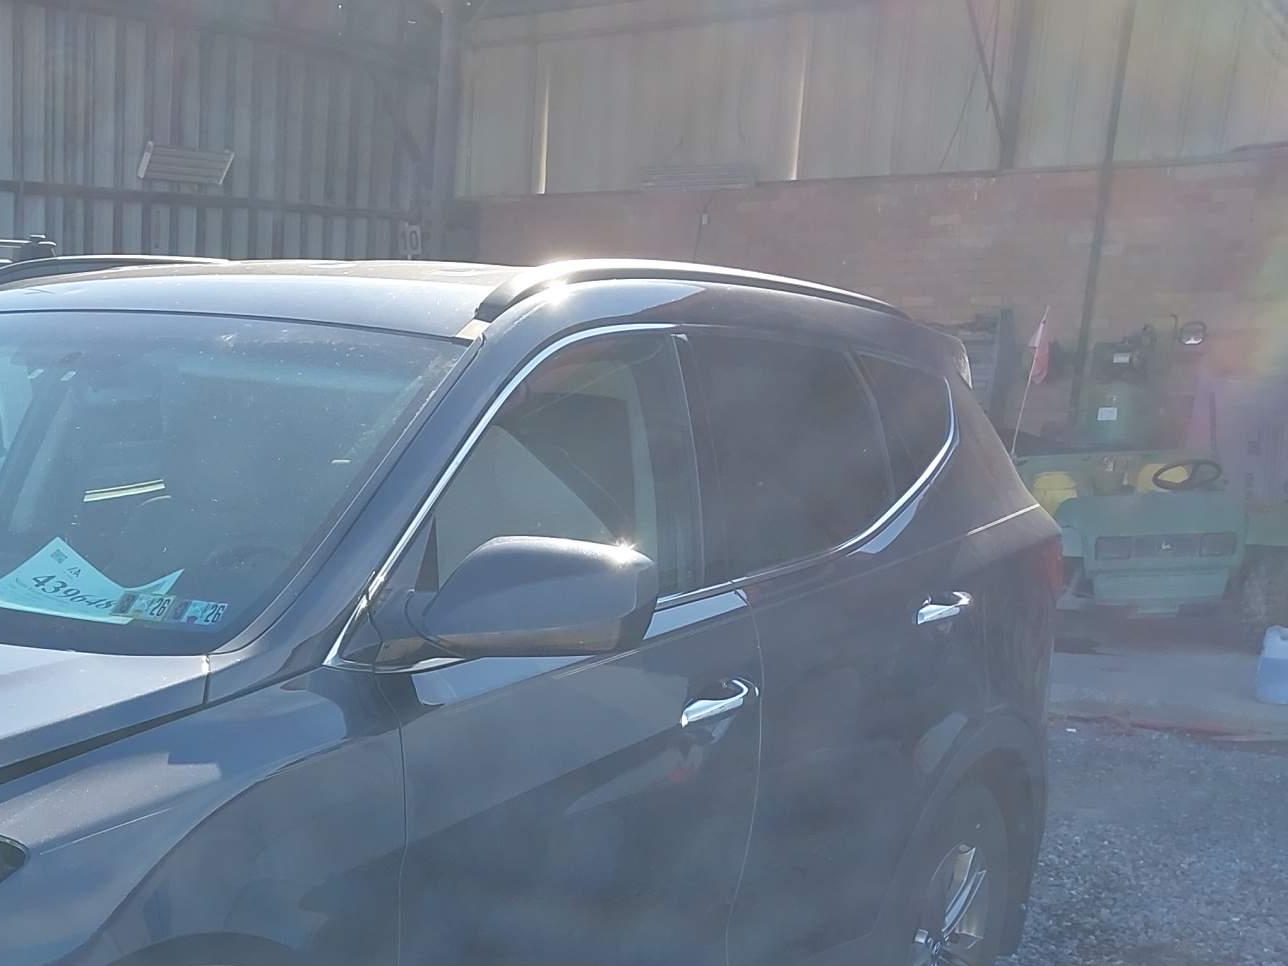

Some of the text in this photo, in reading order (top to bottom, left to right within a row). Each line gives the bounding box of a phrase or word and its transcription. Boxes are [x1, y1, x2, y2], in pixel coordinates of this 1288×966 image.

[32, 575, 117, 609] 439648
[149, 598, 171, 617] 26
[203, 604, 226, 623] 26
